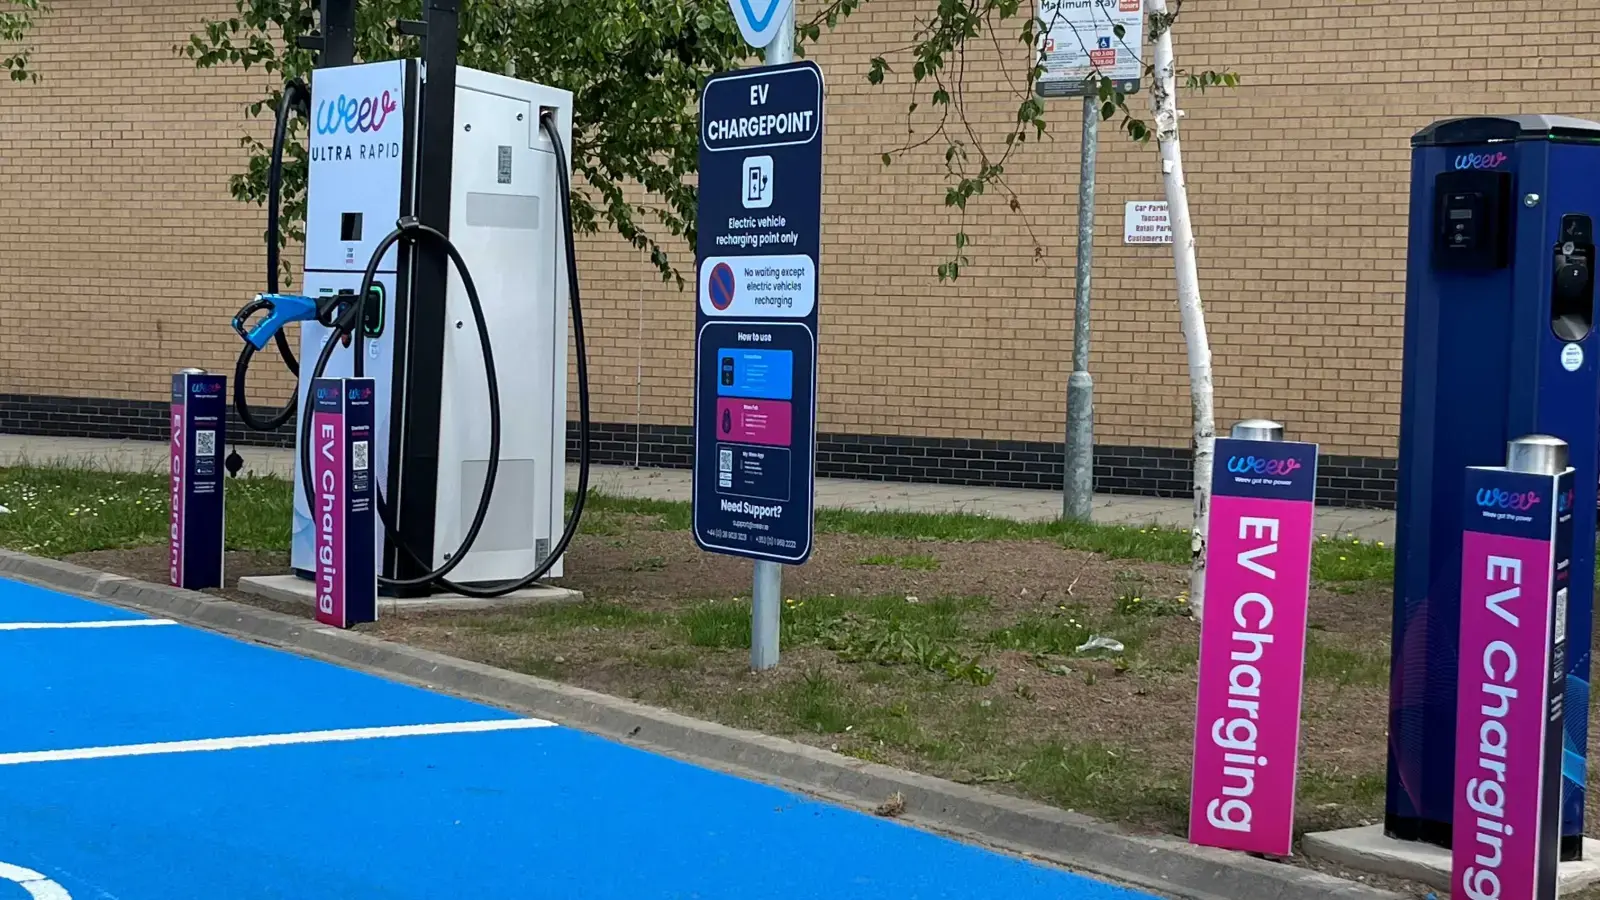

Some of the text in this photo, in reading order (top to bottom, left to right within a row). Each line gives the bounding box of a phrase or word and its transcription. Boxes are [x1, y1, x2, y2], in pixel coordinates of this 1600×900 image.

[750, 83, 769, 106] EV
[317, 90, 397, 135] weev
[708, 110, 813, 140] CHARGEPOINT
[312, 142, 399, 162] ULTRA RAPID
[1454, 152, 1507, 170] weev
[1135, 204, 1147, 212] Car
[728, 214, 786, 229] Electric vehicle
[716, 230, 799, 248] recharging point only
[744, 266, 805, 279] No waiting except
[747, 281, 802, 292] electric vehicles
[754, 296, 793, 308] recharging
[737, 332, 772, 342] How to use
[174, 414, 181, 448] EV
[321, 424, 335, 462] EV
[1227, 455, 1302, 476] weev
[720, 499, 783, 520] Need Support?
[1476, 487, 1541, 511] weev
[171, 455, 181, 584] Charging
[319, 470, 337, 615] Charging
[1236, 516, 1279, 580] EV
[1485, 554, 1522, 628] EV
[1206, 592, 1275, 833] Charging
[1463, 640, 1519, 900] Charging
